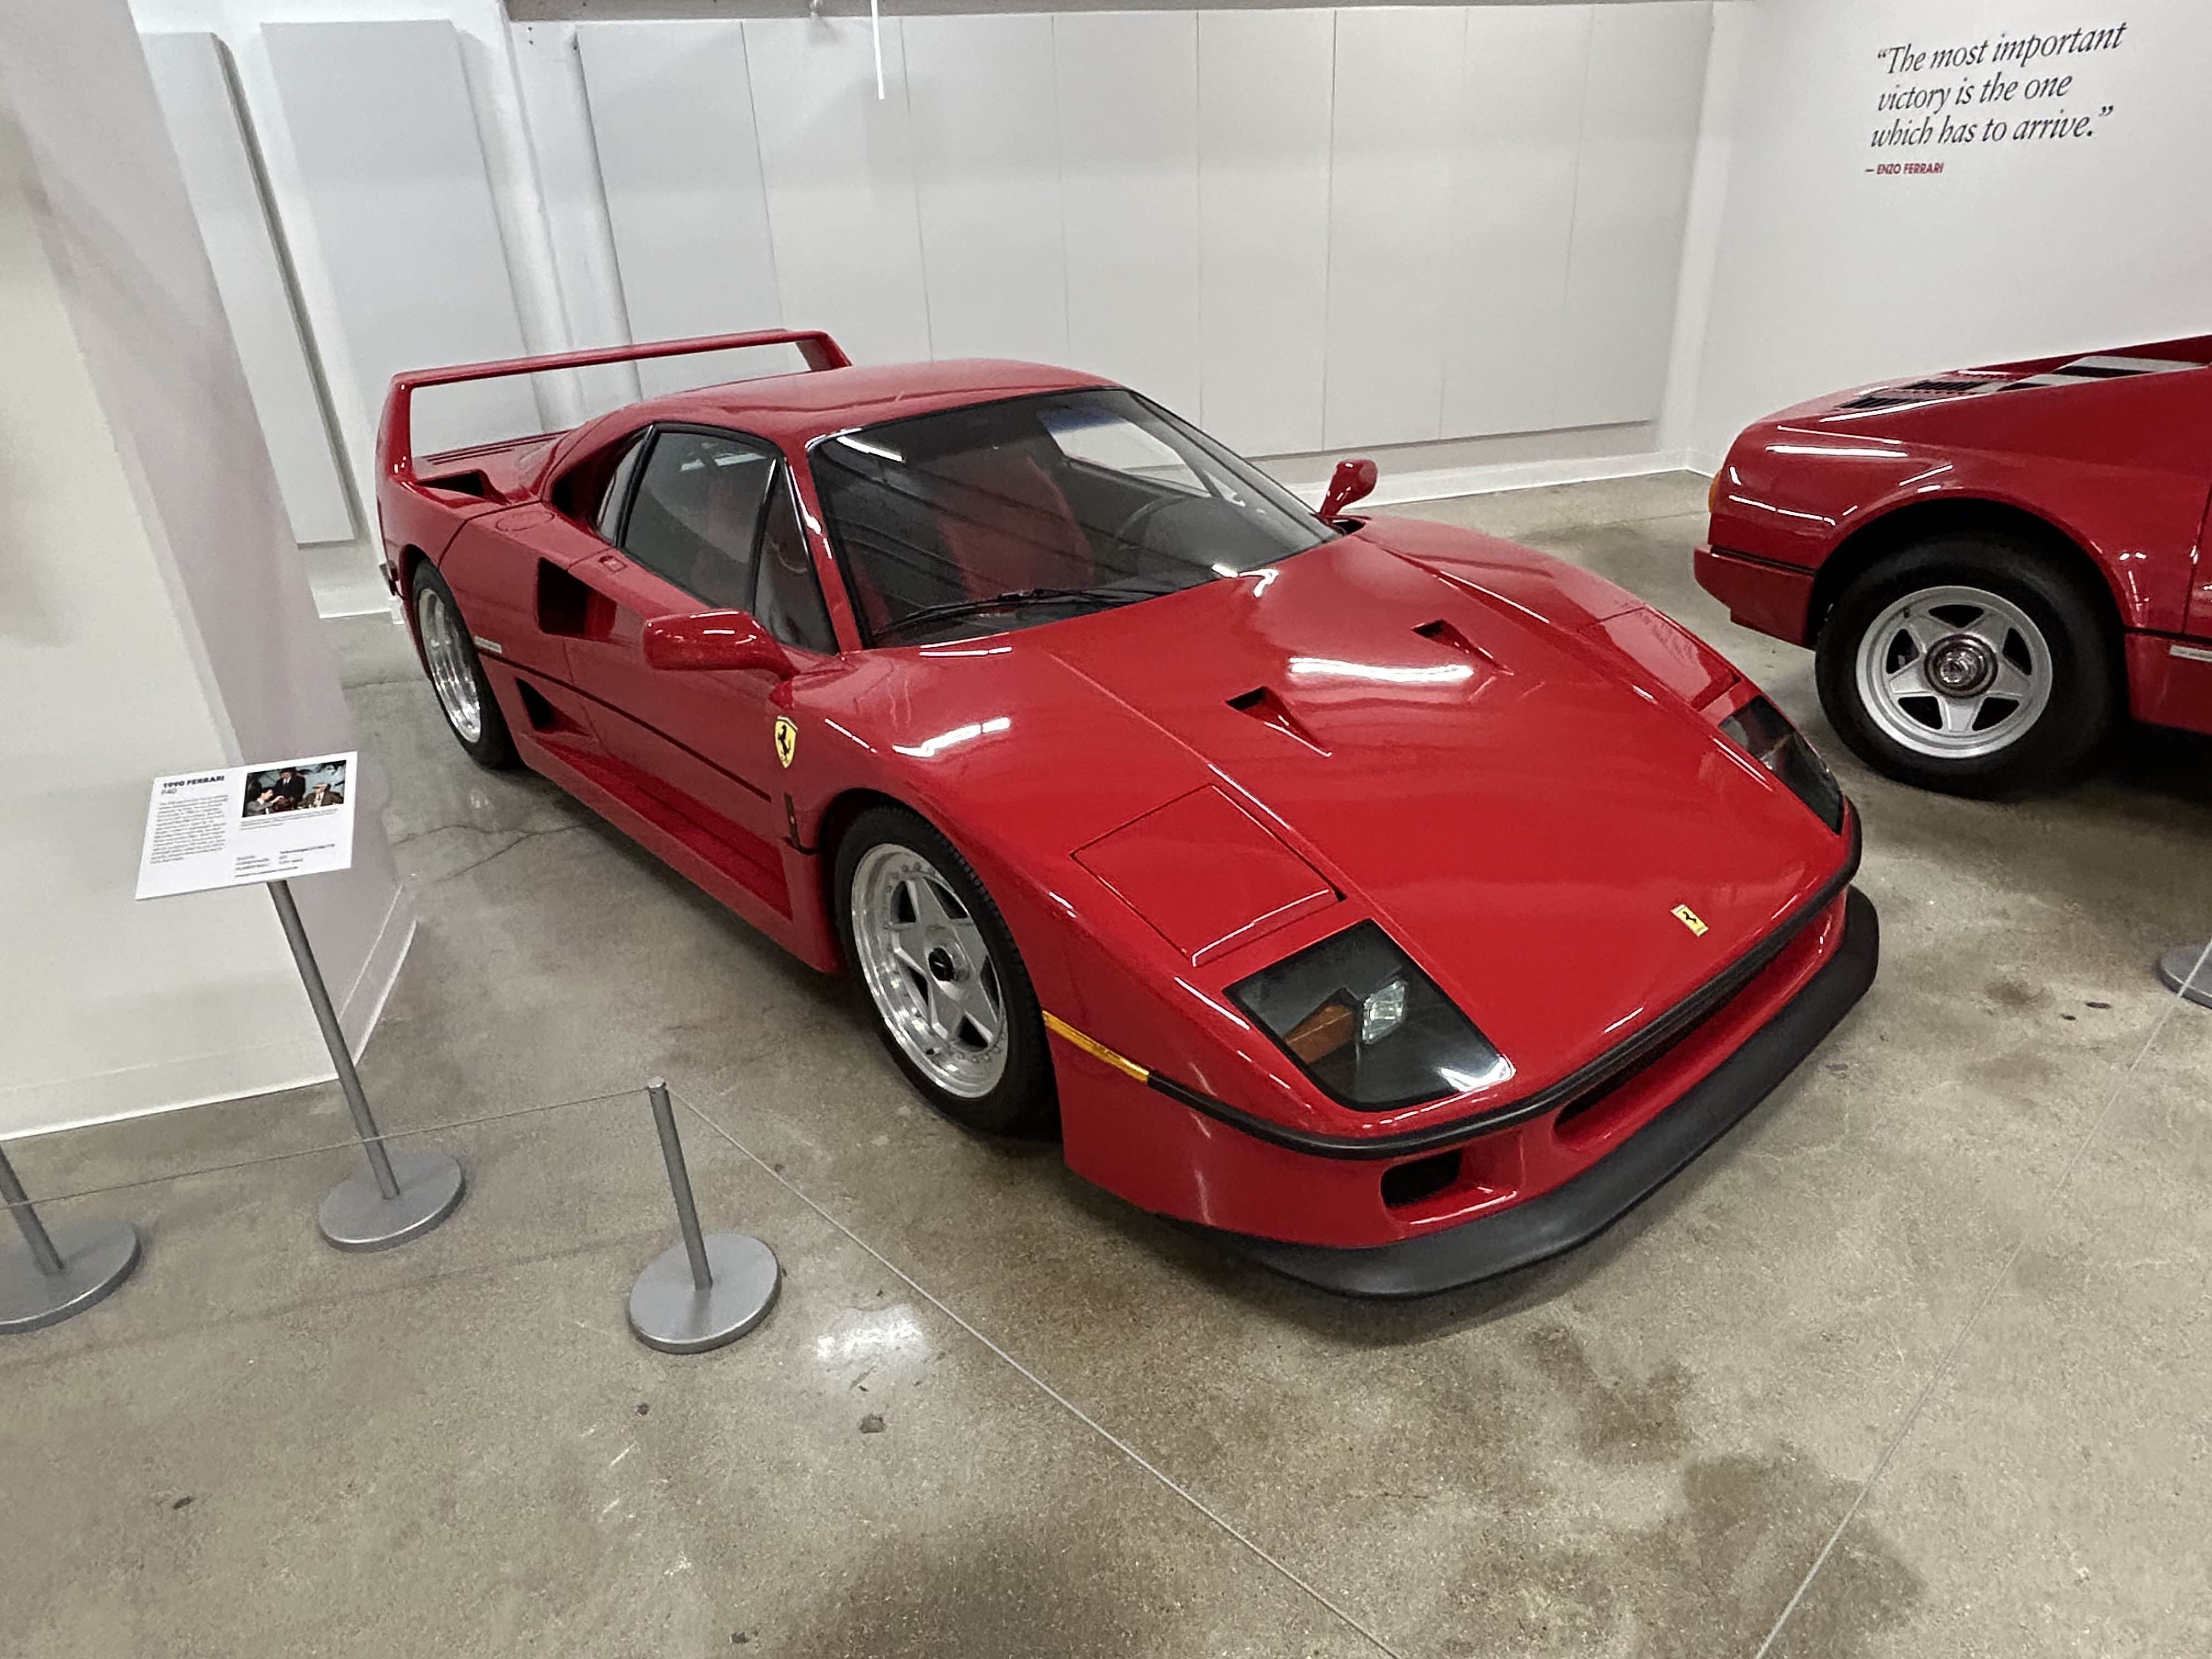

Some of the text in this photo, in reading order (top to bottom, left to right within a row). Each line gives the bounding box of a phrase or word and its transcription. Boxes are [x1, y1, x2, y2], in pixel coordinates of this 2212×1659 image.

[1877, 21, 2128, 75] “The most important
[1877, 70, 2073, 115] victory is the one
[1870, 105, 2114, 148] which has to arrive.”
[1876, 163, 1901, 175] ENZO
[1903, 162, 1944, 174] FERRARI
[163, 775, 225, 788] 1990 FERRARI
